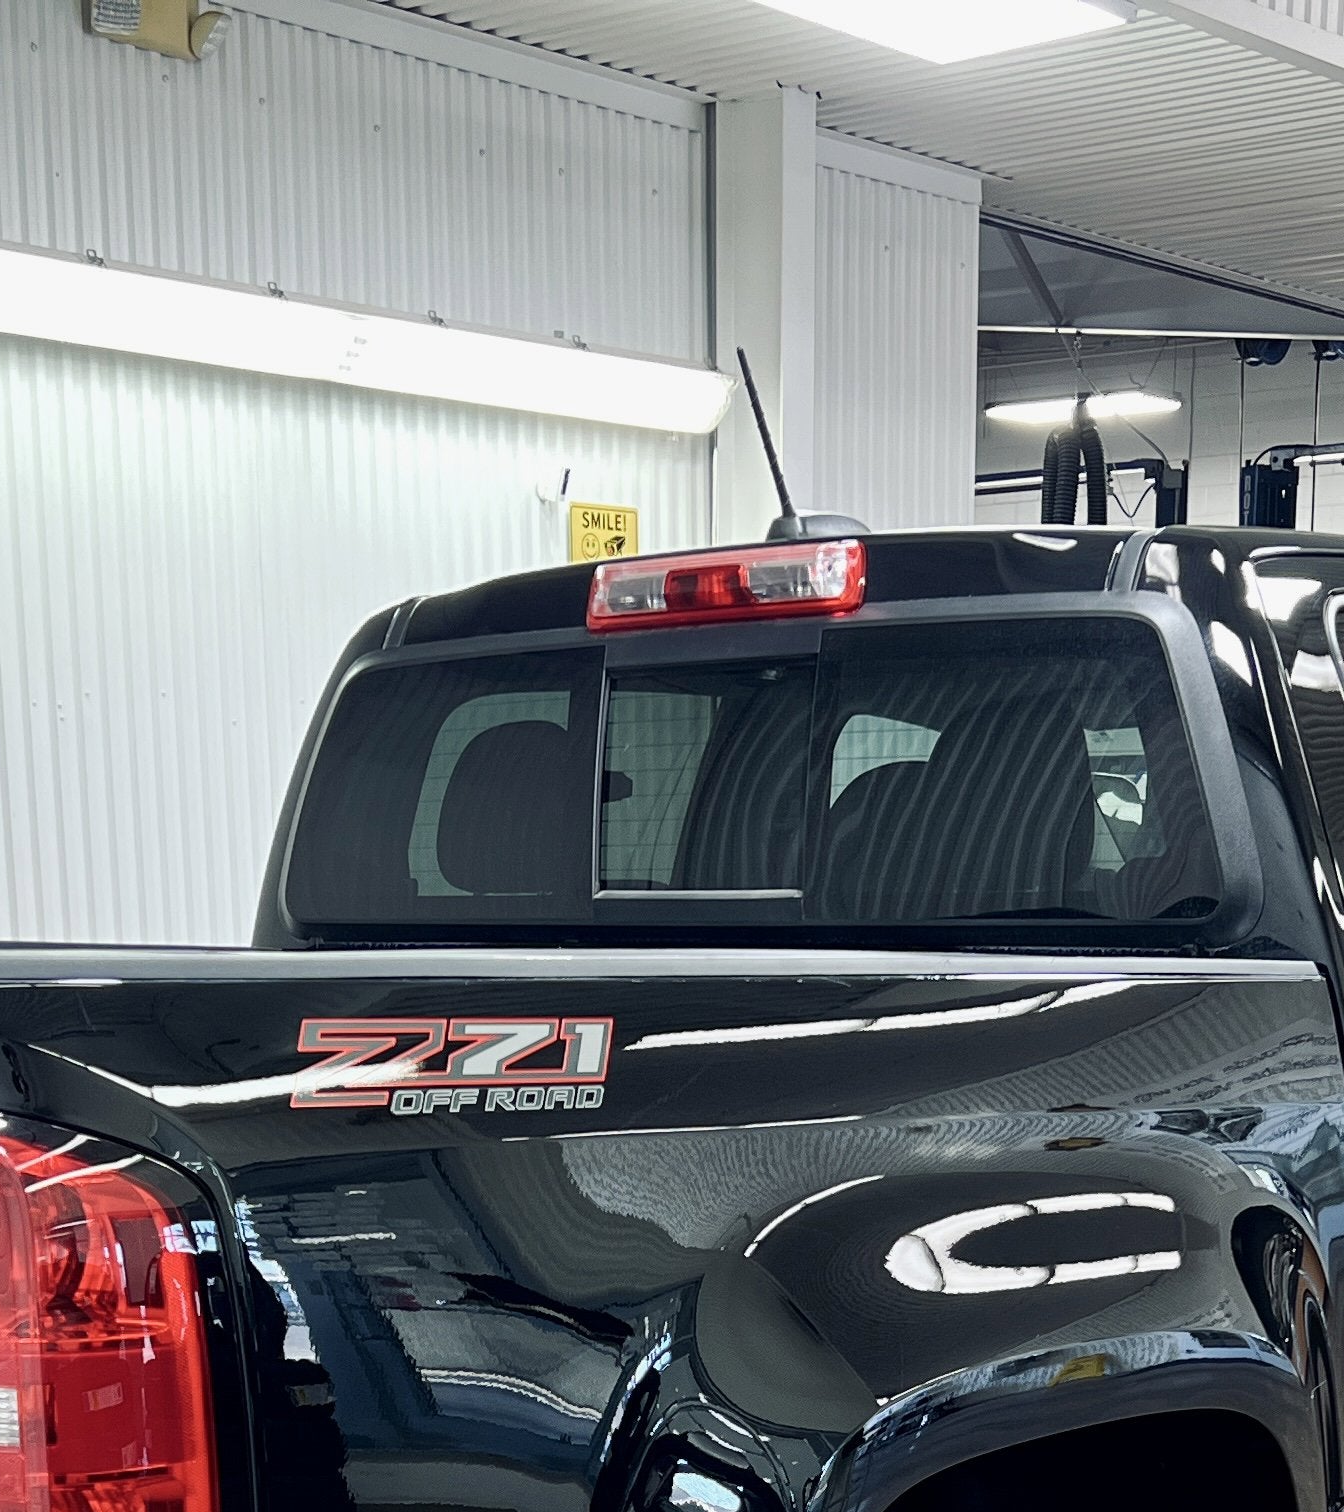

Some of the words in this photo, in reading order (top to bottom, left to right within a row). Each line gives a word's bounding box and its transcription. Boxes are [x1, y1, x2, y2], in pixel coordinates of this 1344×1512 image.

[582, 511, 627, 532] SMILE!
[289, 1017, 614, 1109] Z71
[390, 1087, 479, 1116] OFF
[484, 1085, 605, 1112] ROAD
